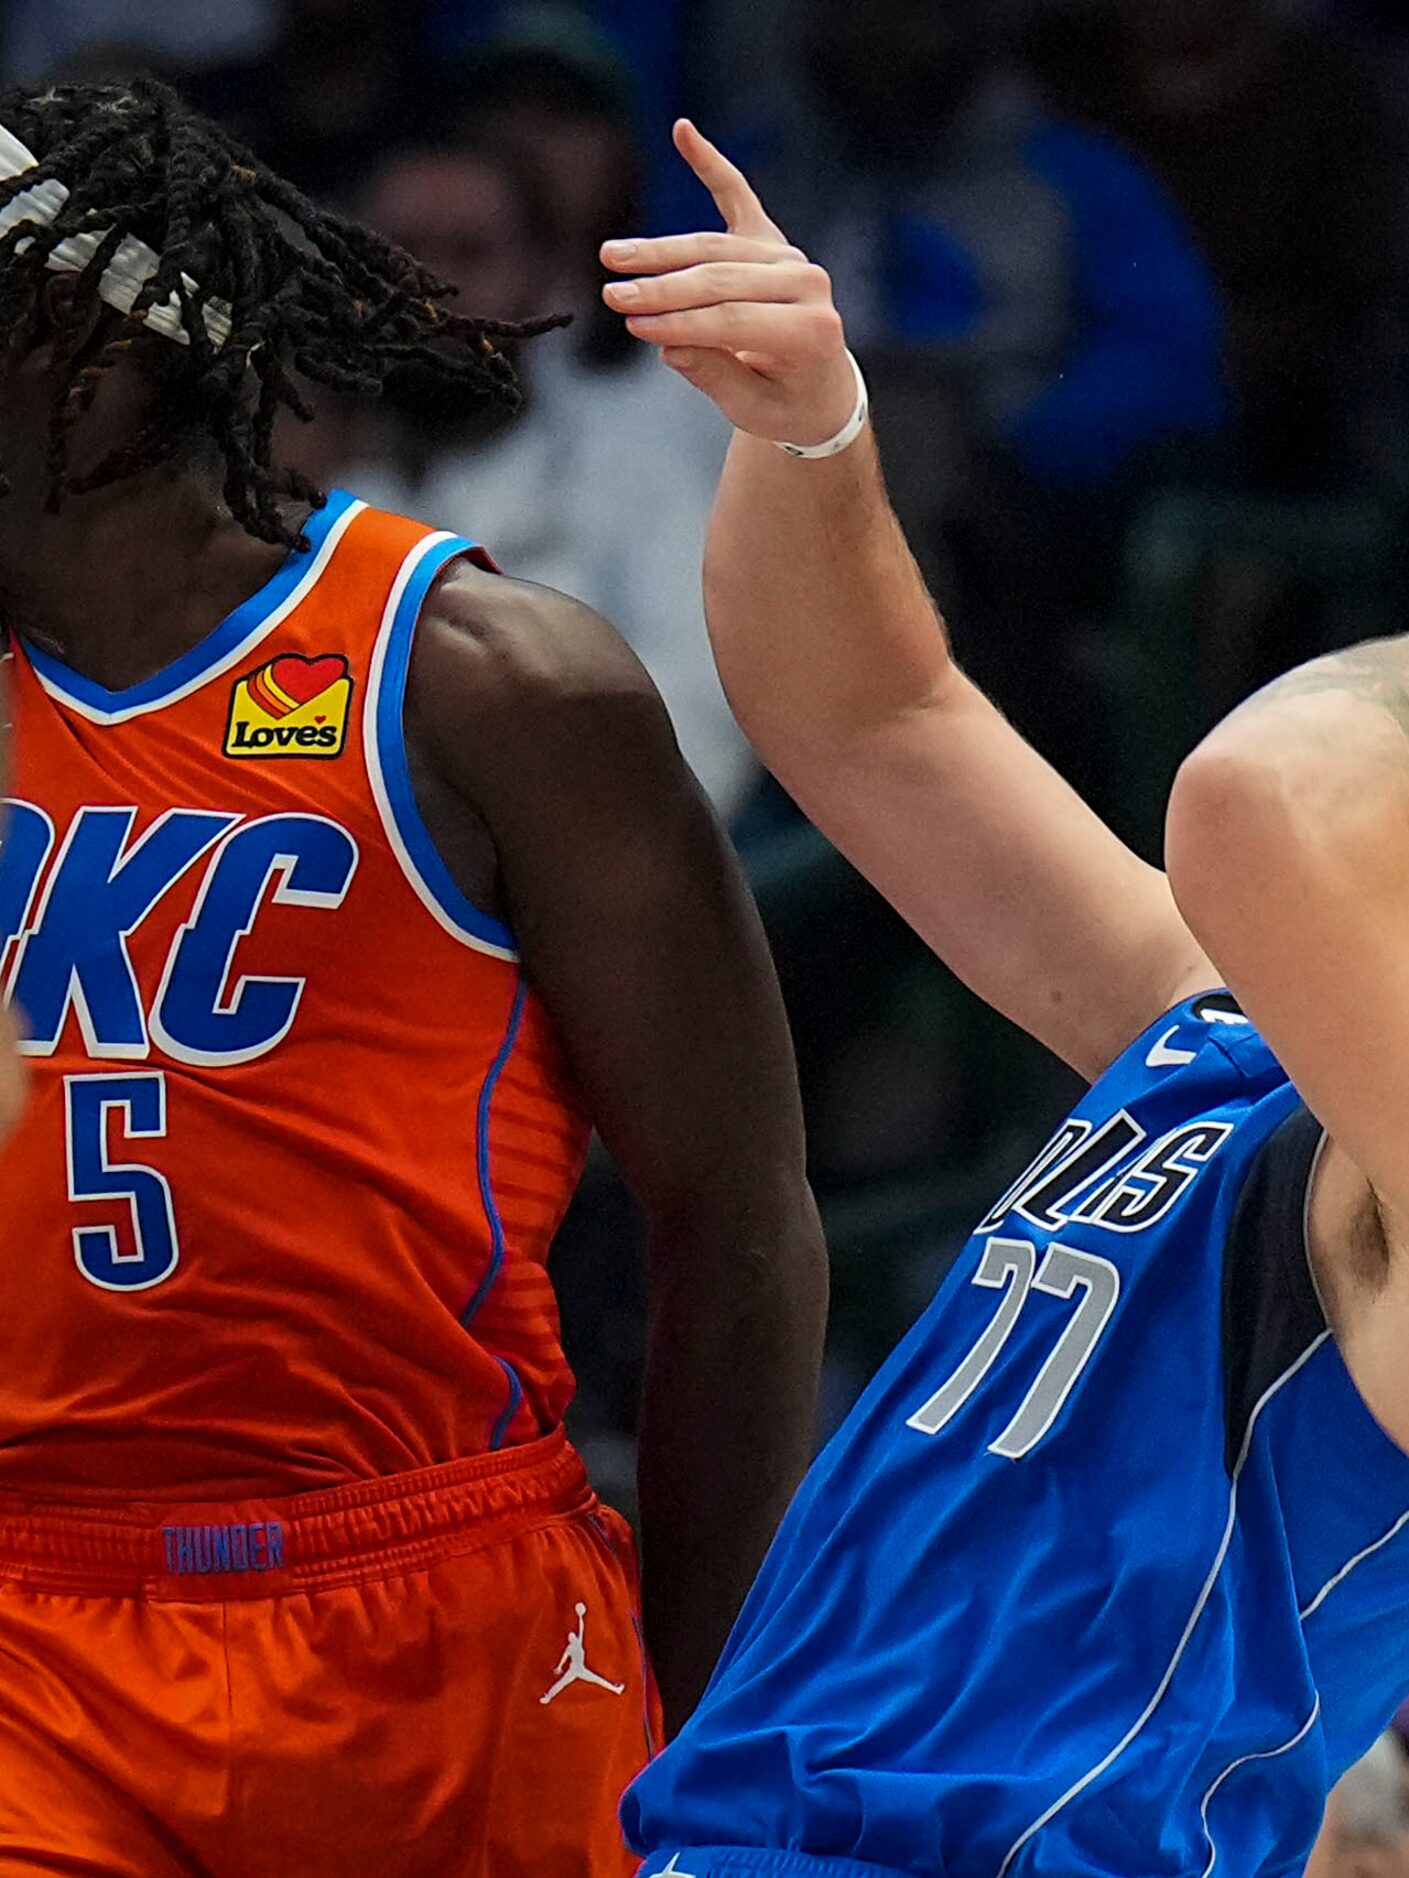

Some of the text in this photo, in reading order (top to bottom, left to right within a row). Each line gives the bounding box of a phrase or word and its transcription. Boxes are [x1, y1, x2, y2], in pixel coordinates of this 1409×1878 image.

[65, 1072, 181, 1292] 5
[907, 1239, 1120, 1459] 77
[163, 1521, 285, 1573] THUNDER
